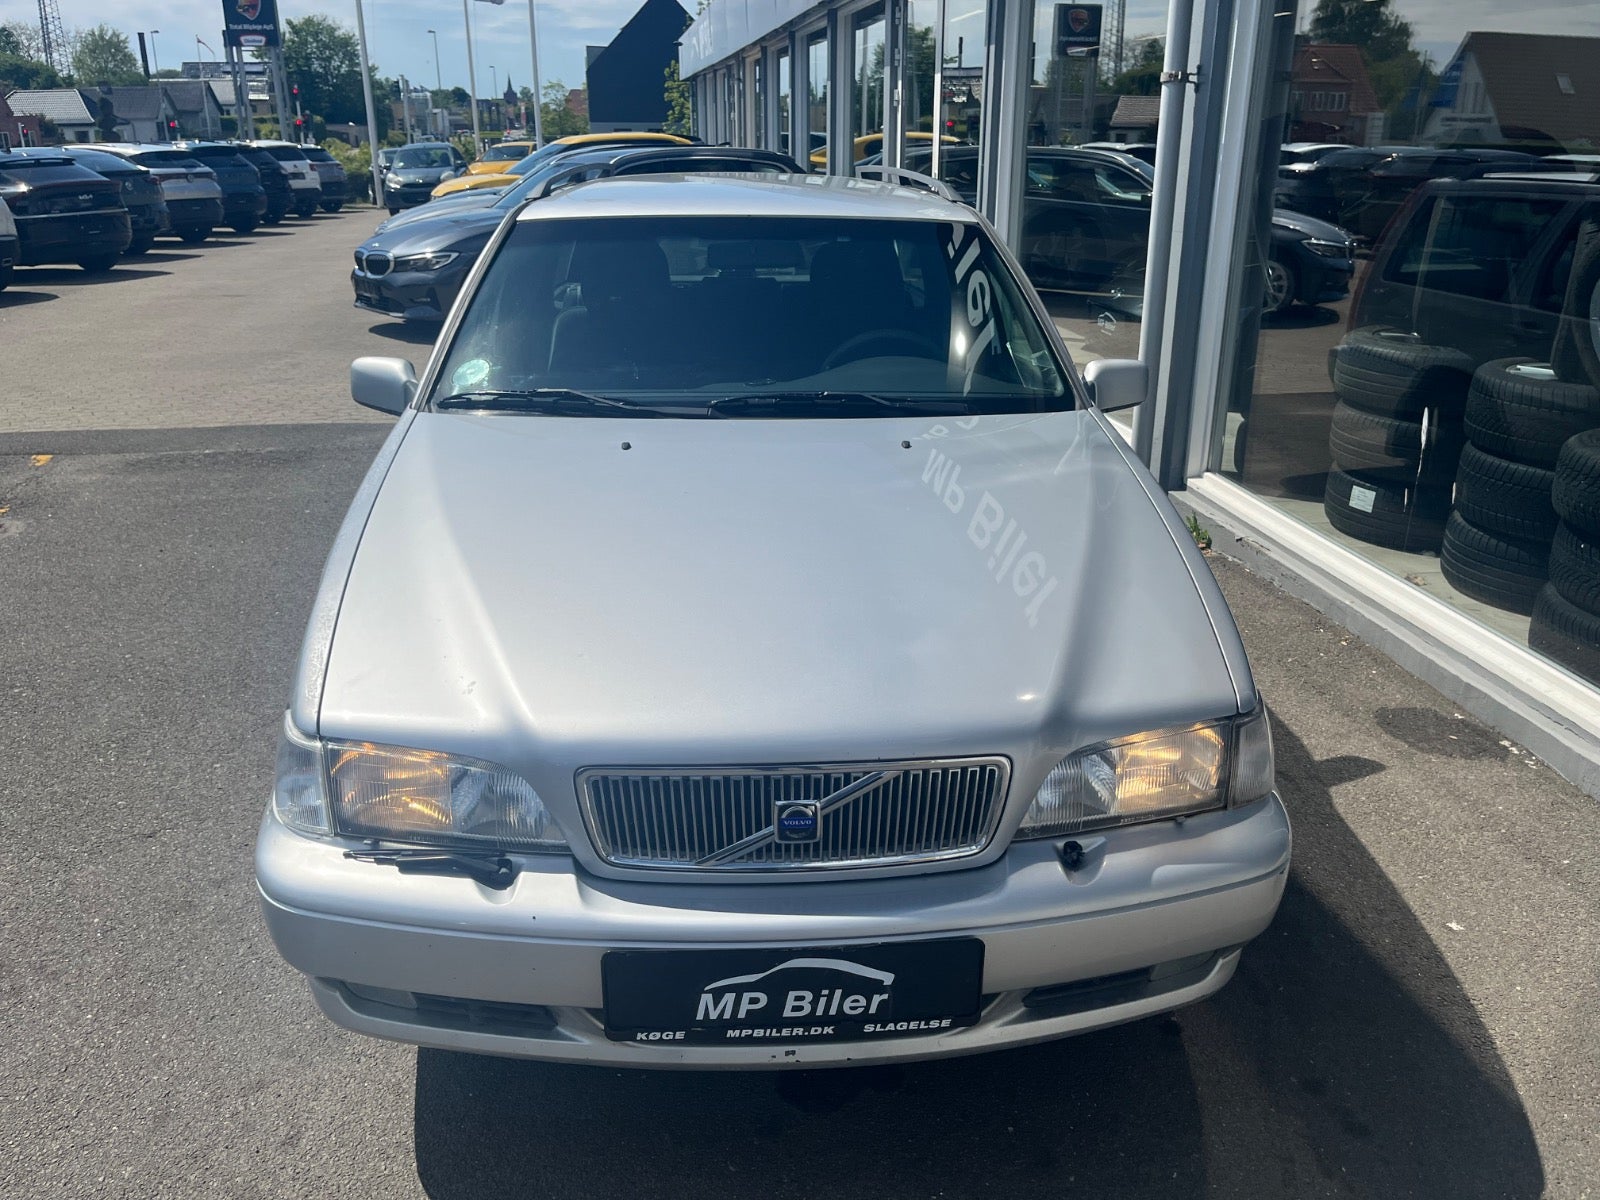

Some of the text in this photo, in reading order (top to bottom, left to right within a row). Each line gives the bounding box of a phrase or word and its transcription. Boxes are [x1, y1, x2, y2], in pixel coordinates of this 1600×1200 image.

[695, 988, 890, 1020] MP Biler
[636, 1019, 952, 1041] KØGE MPBILER.DK SLAGELSE
